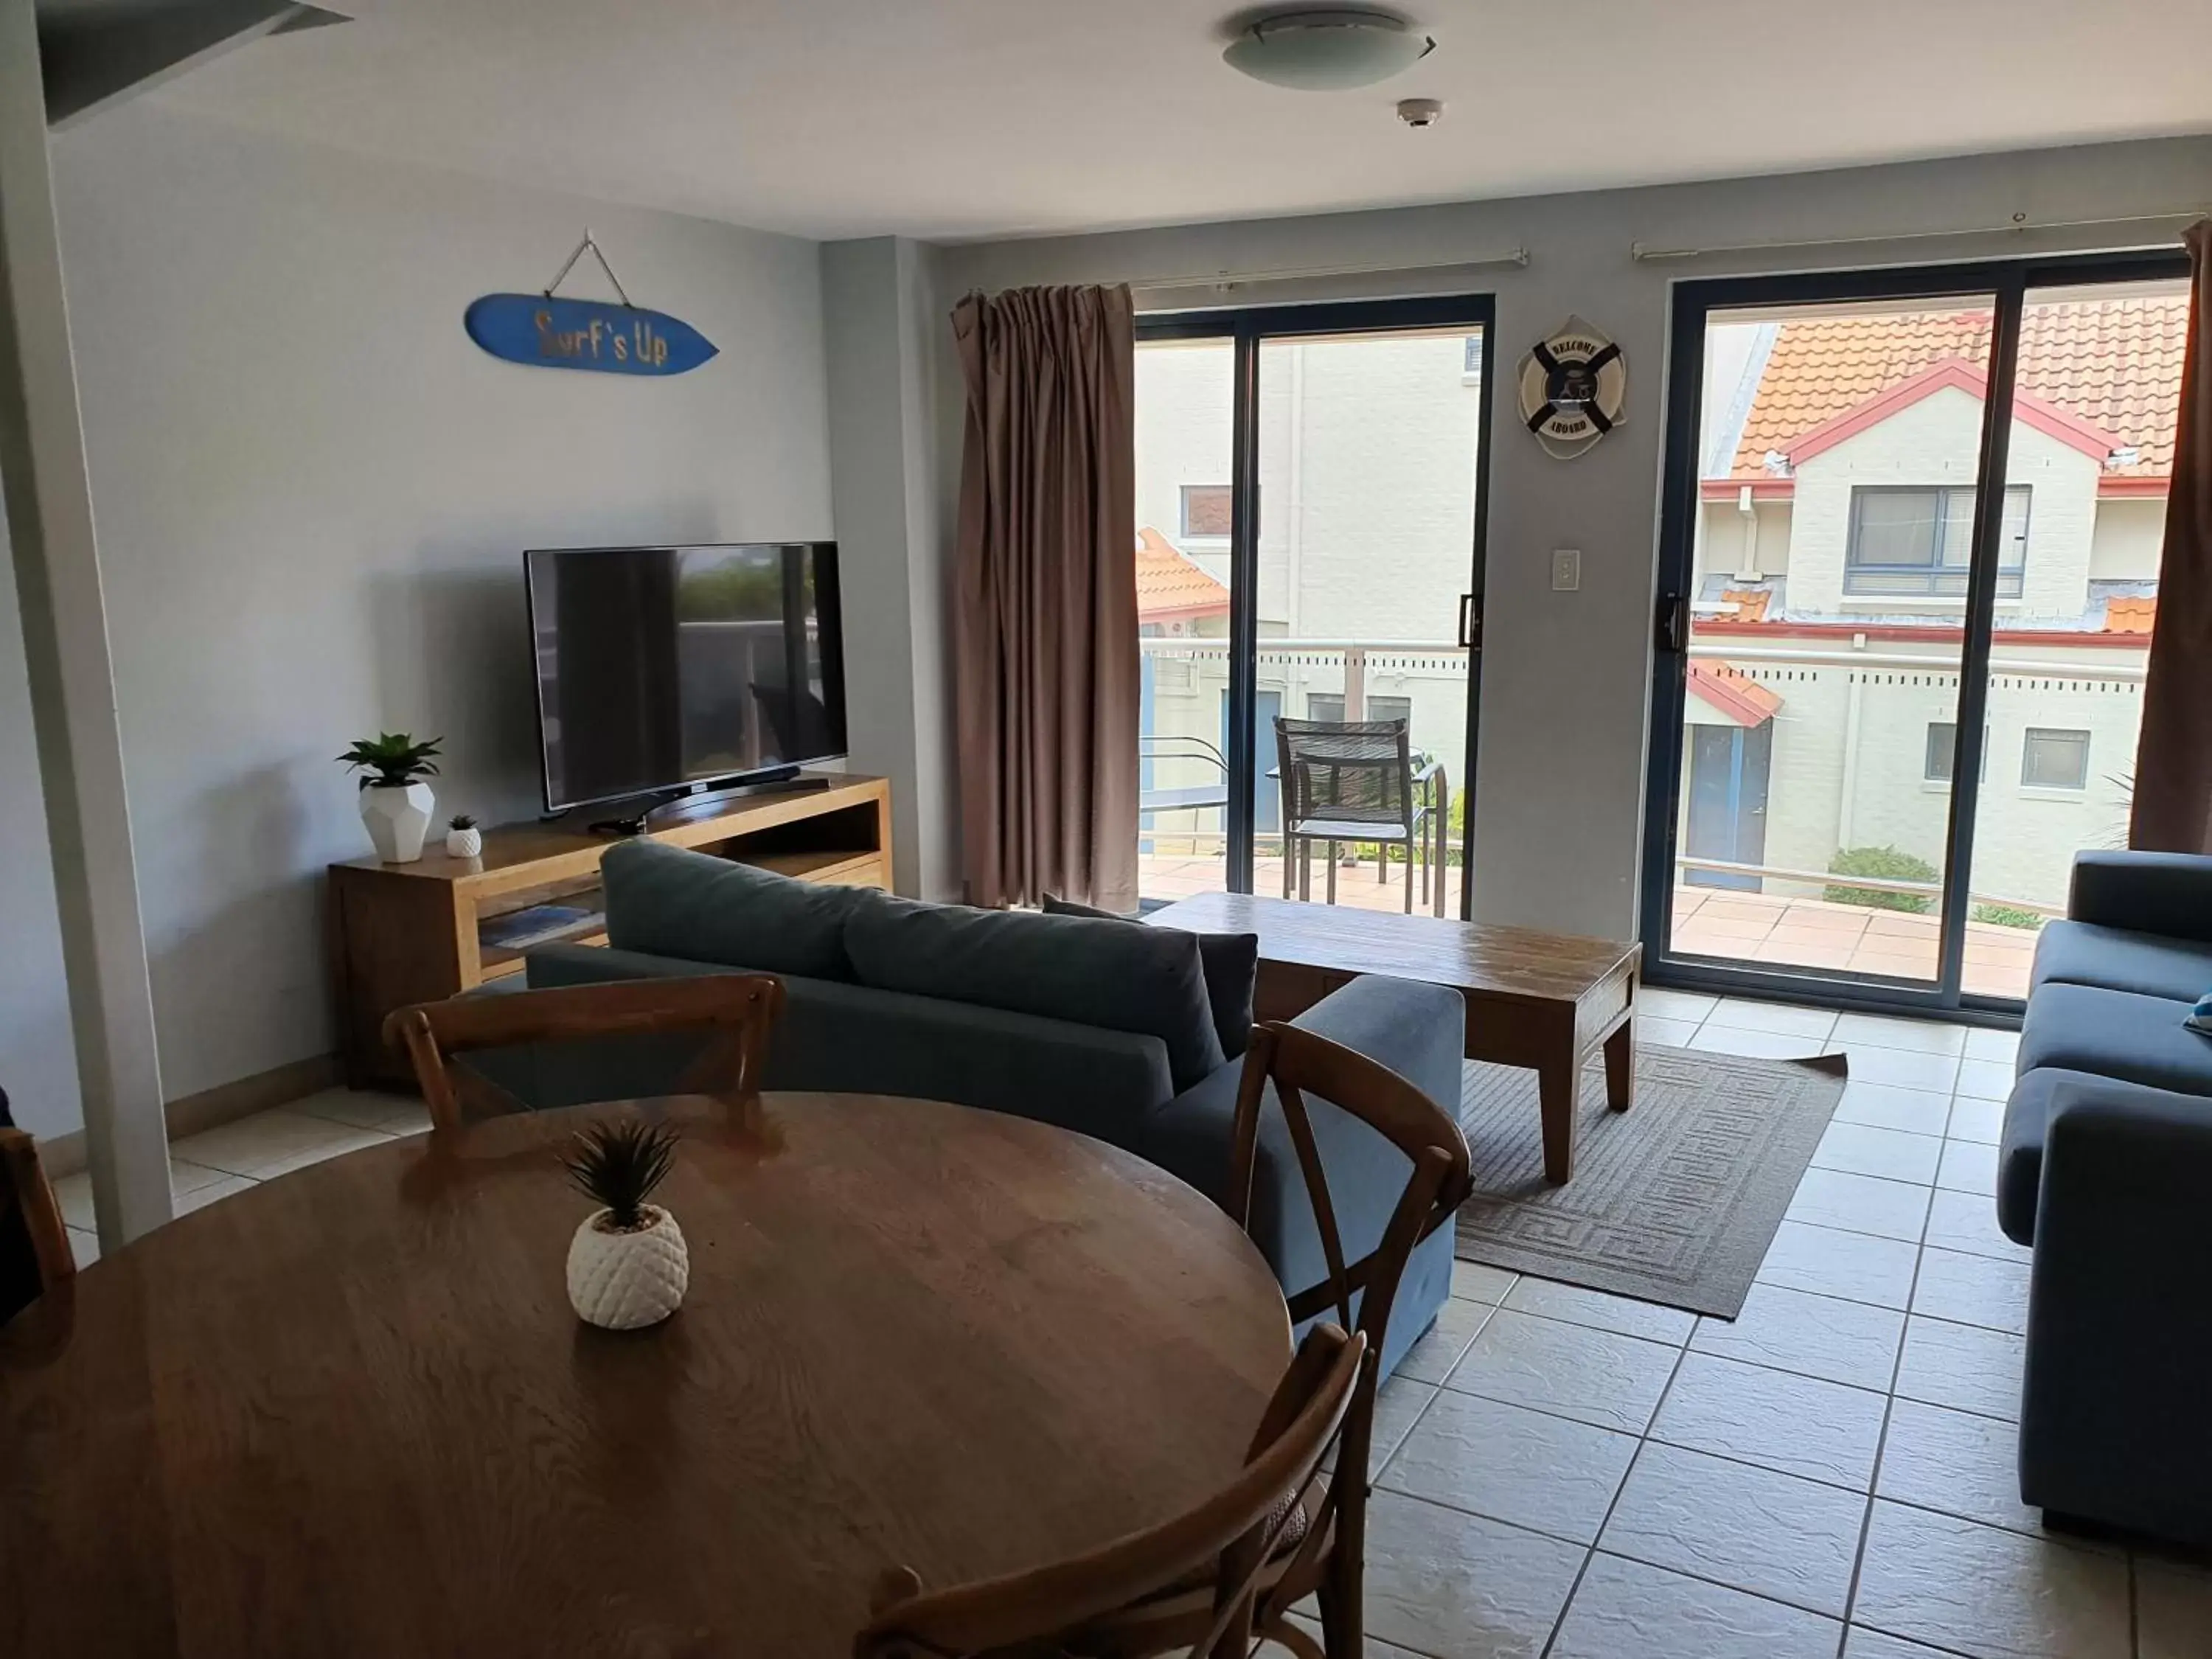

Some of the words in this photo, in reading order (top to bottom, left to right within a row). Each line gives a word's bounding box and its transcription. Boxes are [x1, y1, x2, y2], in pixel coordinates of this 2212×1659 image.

[535, 311, 627, 360] Surf's
[634, 320, 668, 367] Up
[1552, 340, 1596, 355] WELCOME
[1551, 420, 1586, 434] ABOARD
